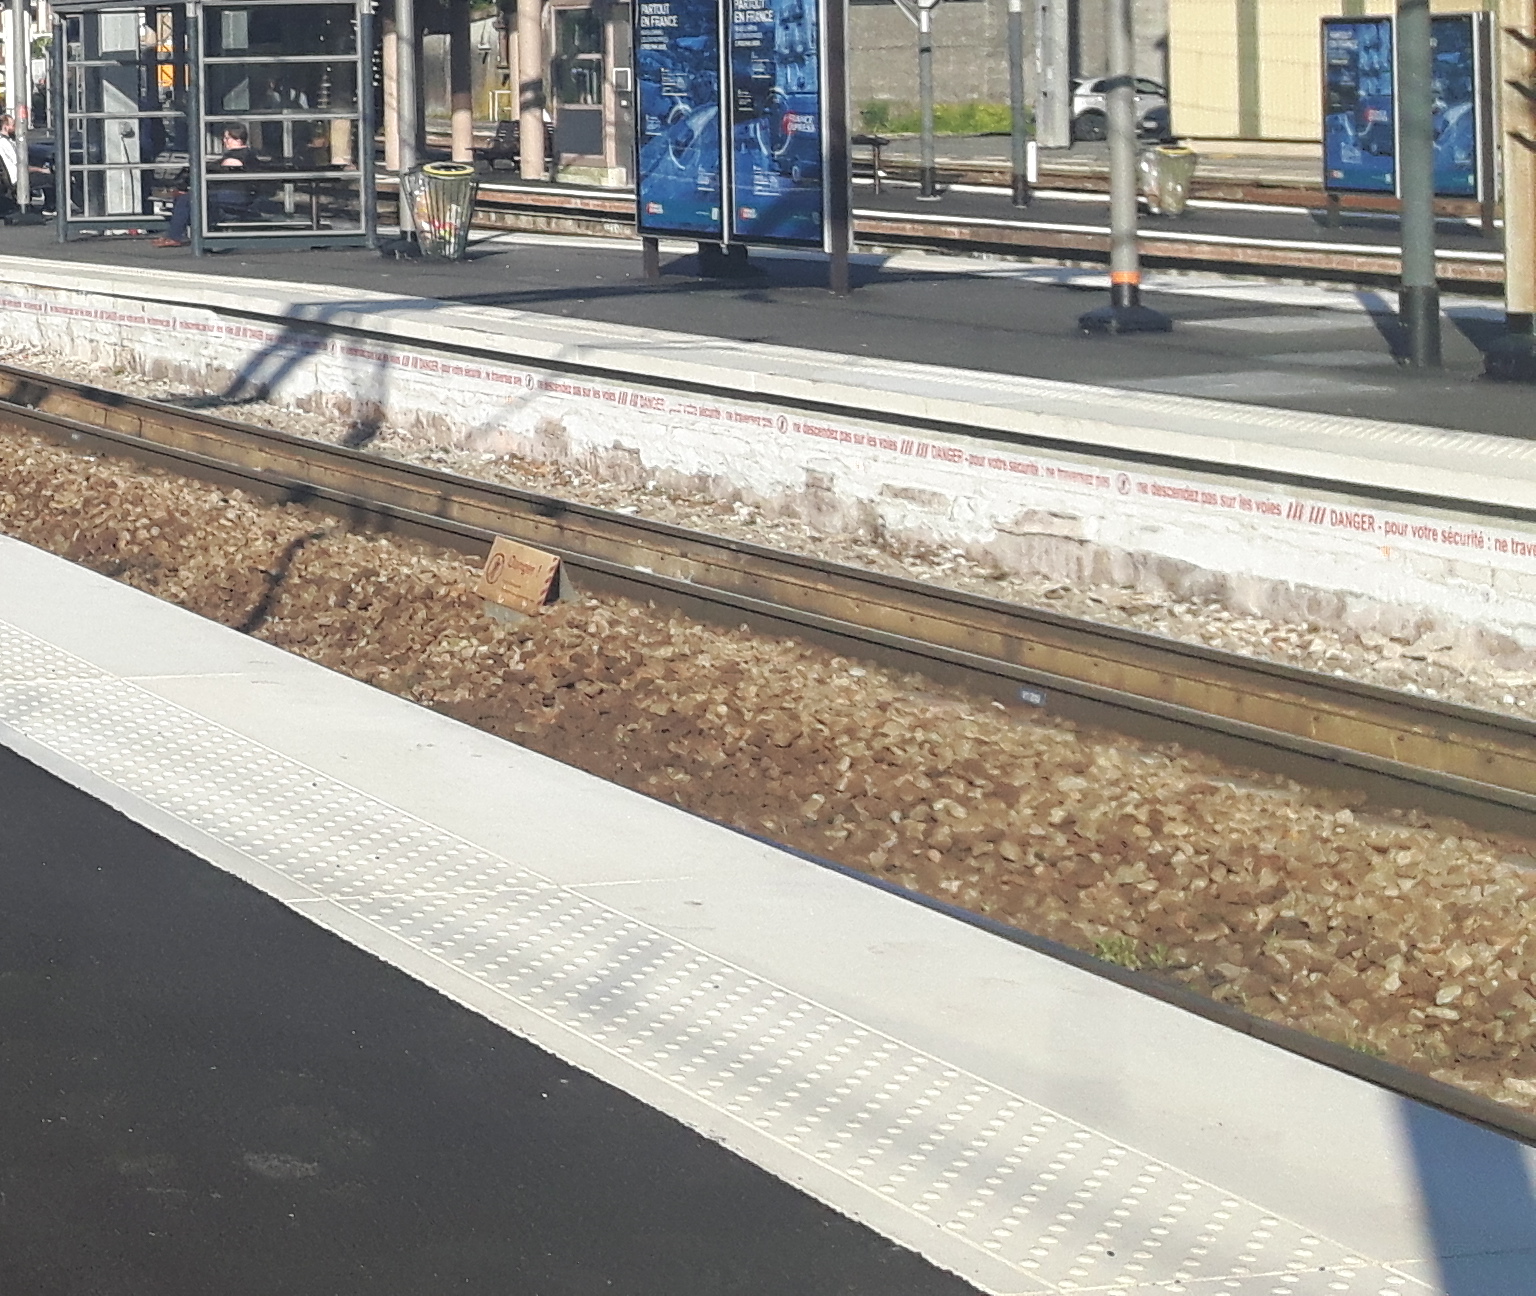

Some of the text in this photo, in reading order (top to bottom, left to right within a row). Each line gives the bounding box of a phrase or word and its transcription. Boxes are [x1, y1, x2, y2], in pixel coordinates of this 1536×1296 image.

[1330, 509, 1376, 532] DANGER
[1384, 520, 1408, 537] pour
[1411, 524, 1439, 542] votre
[1494, 538, 1508, 553] ne
